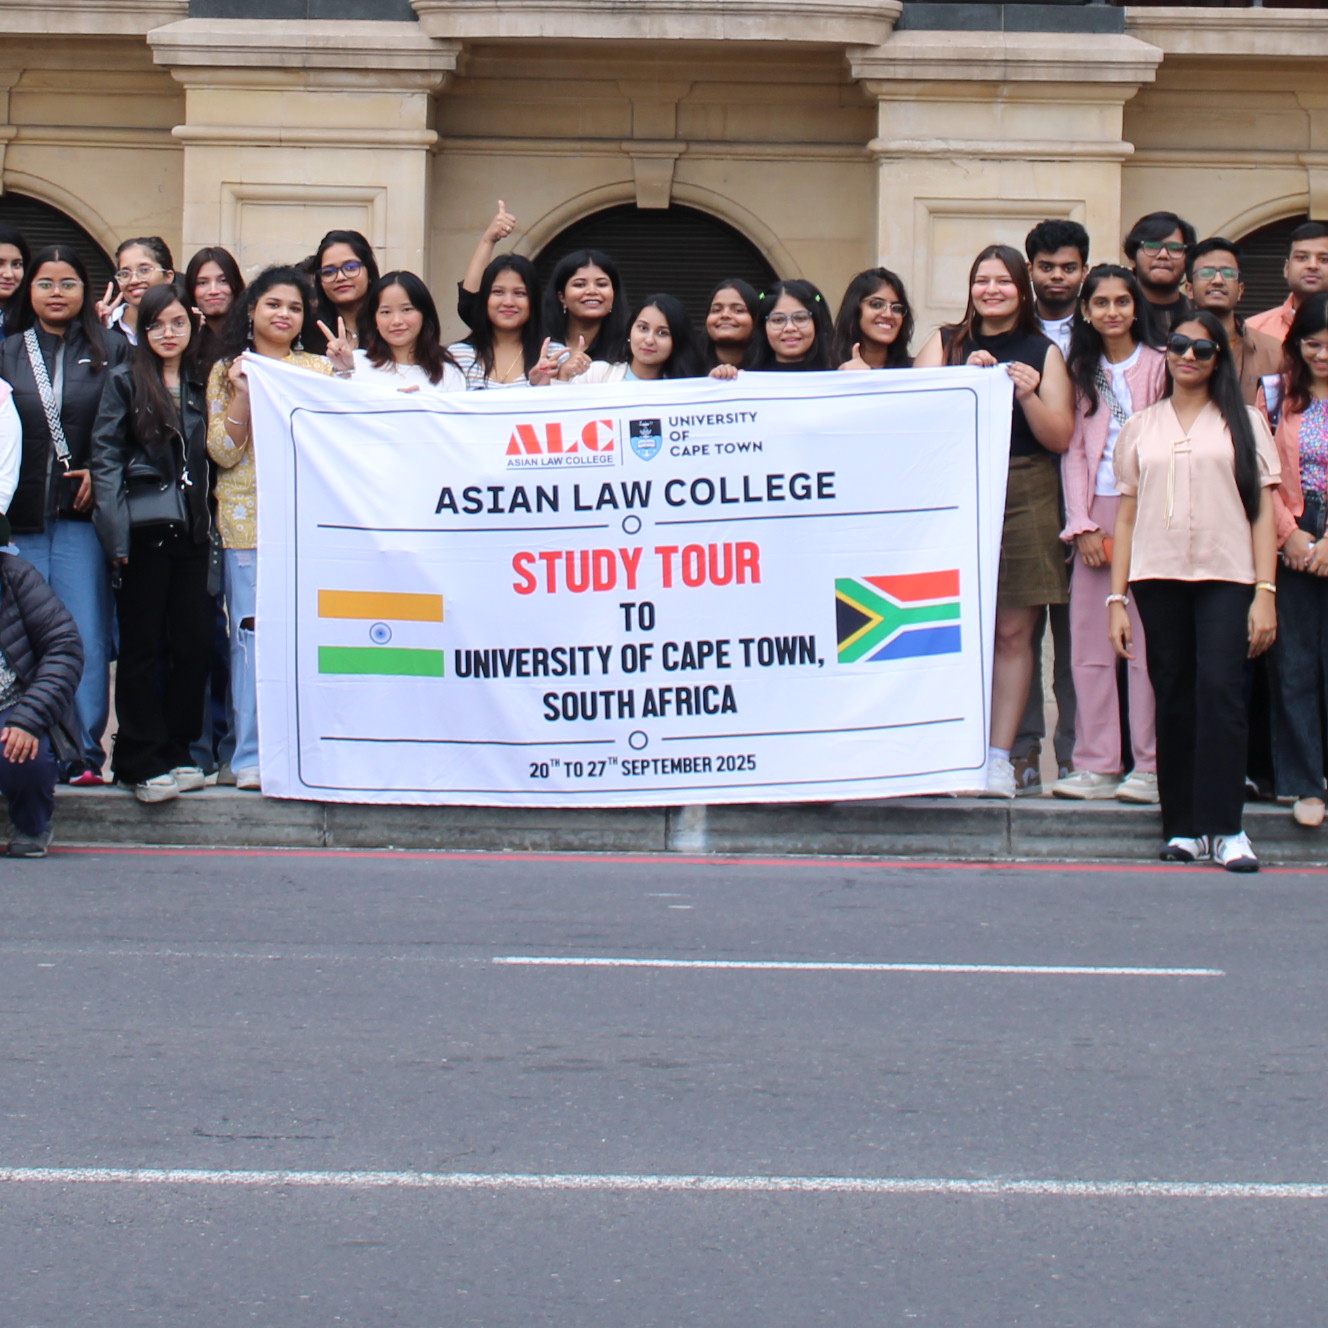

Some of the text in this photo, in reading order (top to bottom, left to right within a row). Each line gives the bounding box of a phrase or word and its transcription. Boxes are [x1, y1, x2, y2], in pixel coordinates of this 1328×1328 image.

[668, 412, 758, 427] UNIVERSITY
[506, 419, 615, 456] ALC
[669, 431, 690, 442] OF
[669, 441, 764, 457] CAPE TOWN
[507, 455, 614, 467] ASIAN LAW COLLEGE
[434, 471, 837, 516] ASIAN LAW COLLEGE
[512, 541, 761, 595] STUDY TOUR
[619, 601, 656, 633] TO
[454, 634, 825, 680] UNIVERSITY OF CAPE TOWN,
[542, 684, 738, 723] SOUTH AFRICA
[563, 761, 584, 779] TO
[621, 756, 713, 777] SEPTEMBER
[715, 754, 757, 773] 2025
